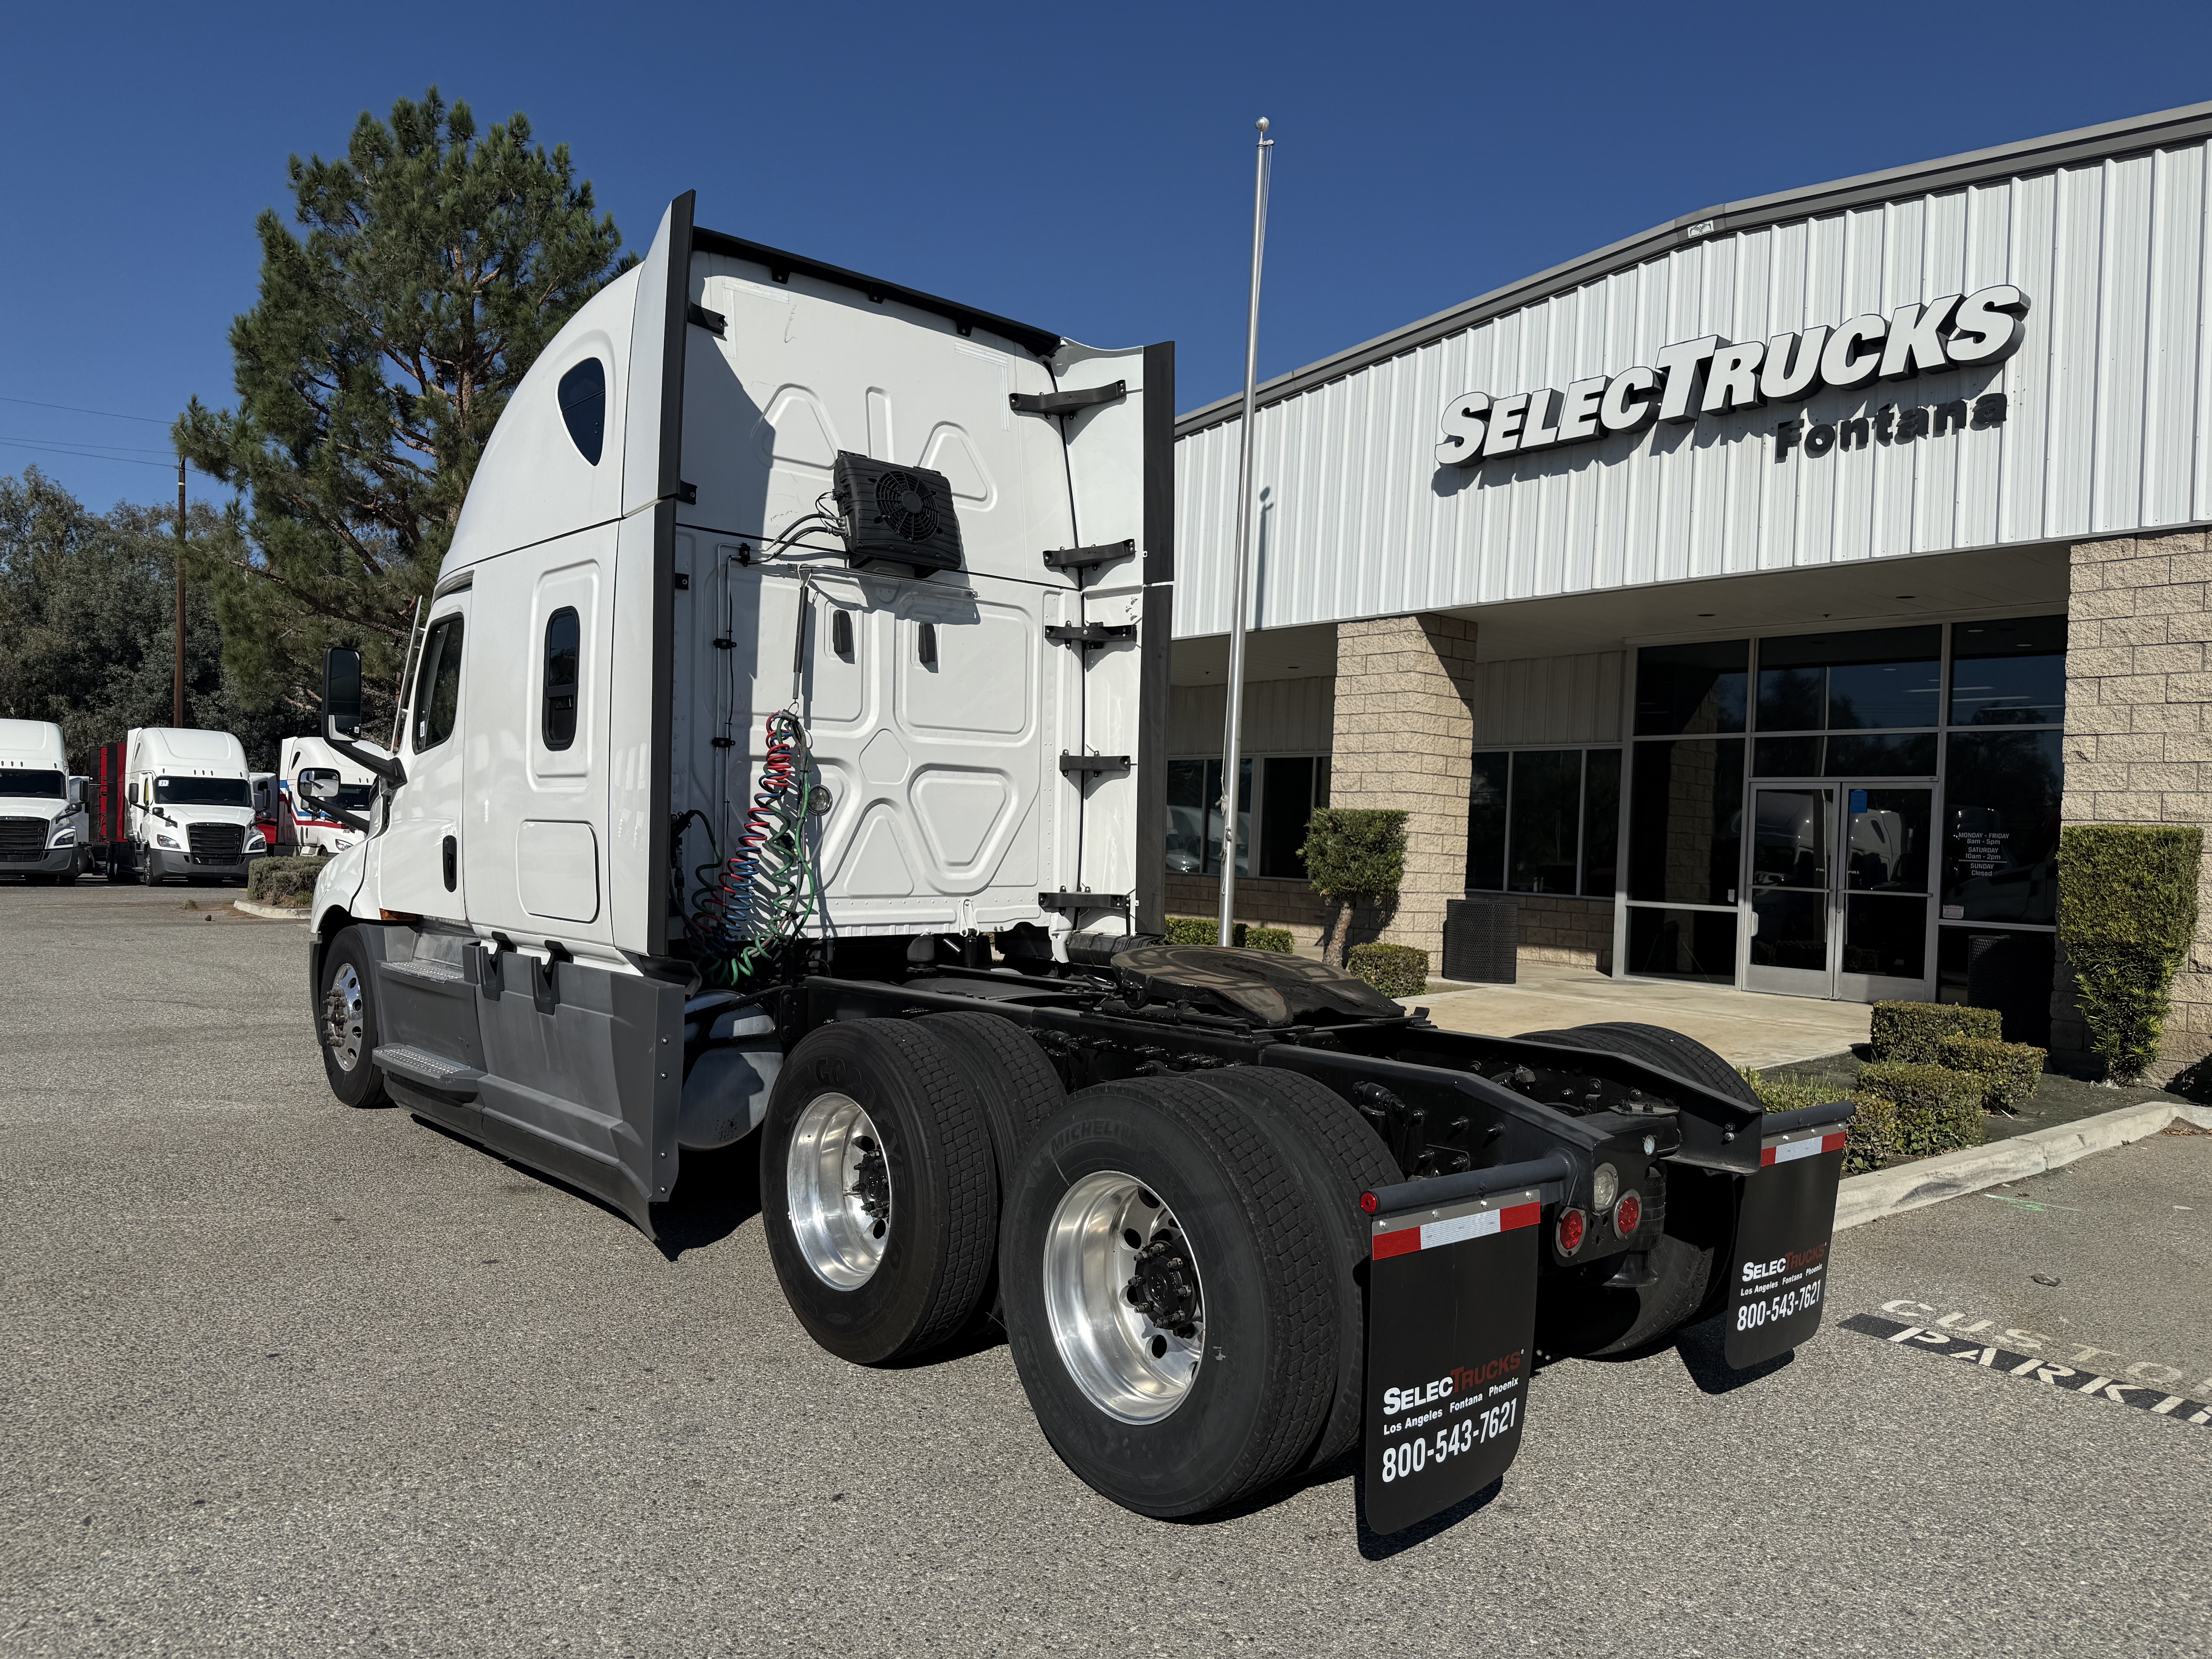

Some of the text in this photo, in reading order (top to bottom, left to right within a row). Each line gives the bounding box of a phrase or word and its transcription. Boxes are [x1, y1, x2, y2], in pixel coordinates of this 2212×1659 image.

[1776, 392, 2007, 459] Fontana
[1051, 1119, 1132, 1155] MICHELIN
[1737, 1279, 1821, 1331] 800-543-7621
[1740, 1263, 1822, 1296] Los Angeles Fontana Phoenix
[1881, 1300, 2212, 1395] CUSTO
[1384, 1377, 1518, 1435] Los Angeles Fontana Phoenix
[1382, 1398, 1517, 1483] 800-543-7621
